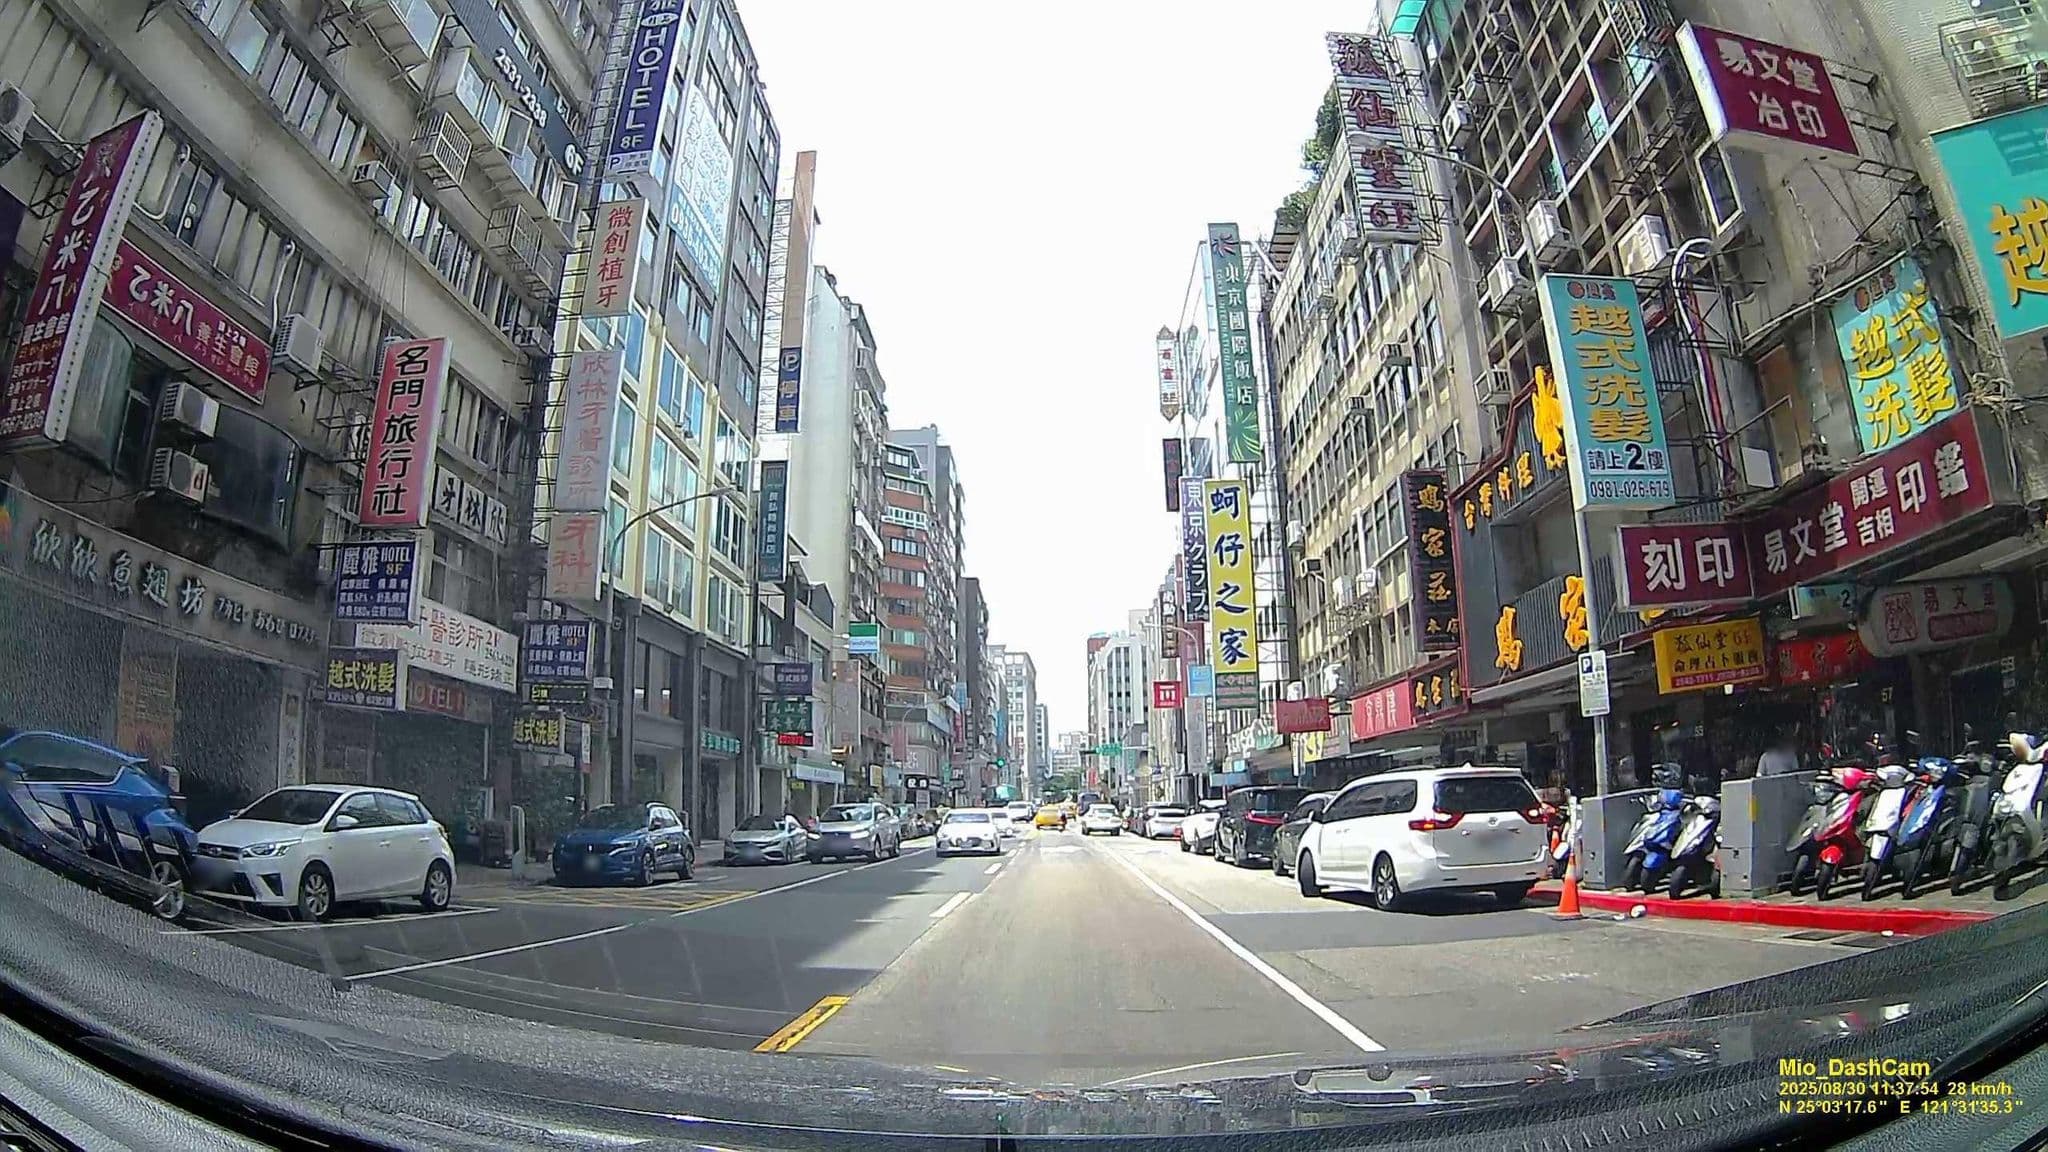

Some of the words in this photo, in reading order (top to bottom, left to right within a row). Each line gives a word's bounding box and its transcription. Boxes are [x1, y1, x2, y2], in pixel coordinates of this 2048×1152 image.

[626, 26, 667, 130] HOTEL
[1716, 37, 1821, 95] 易文堂
[564, 143, 586, 176] 6F
[609, 156, 621, 170] P
[620, 134, 644, 149] 8F
[597, 206, 634, 308] 微創植牙
[1224, 261, 1254, 406] 東京國際飯店
[1569, 304, 1652, 443] 越式洗髮
[372, 345, 430, 516] 名門旅行社
[1588, 443, 1665, 472] 請上2樓
[1589, 478, 1670, 499] 0981-026-679
[381, 546, 411, 562] HOTEL
[553, 518, 597, 578] 牙科
[1764, 499, 1847, 576] 易文堂
[1856, 505, 1895, 548] 吉相
[33, 518, 207, 615] 欣欣魚翅坊
[386, 563, 403, 576] 8F
[1210, 485, 1251, 666] 蚵仔之家
[1641, 536, 1737, 593] 刻印
[327, 659, 395, 694] 越式洗髮
[1583, 657, 1591, 673] P
